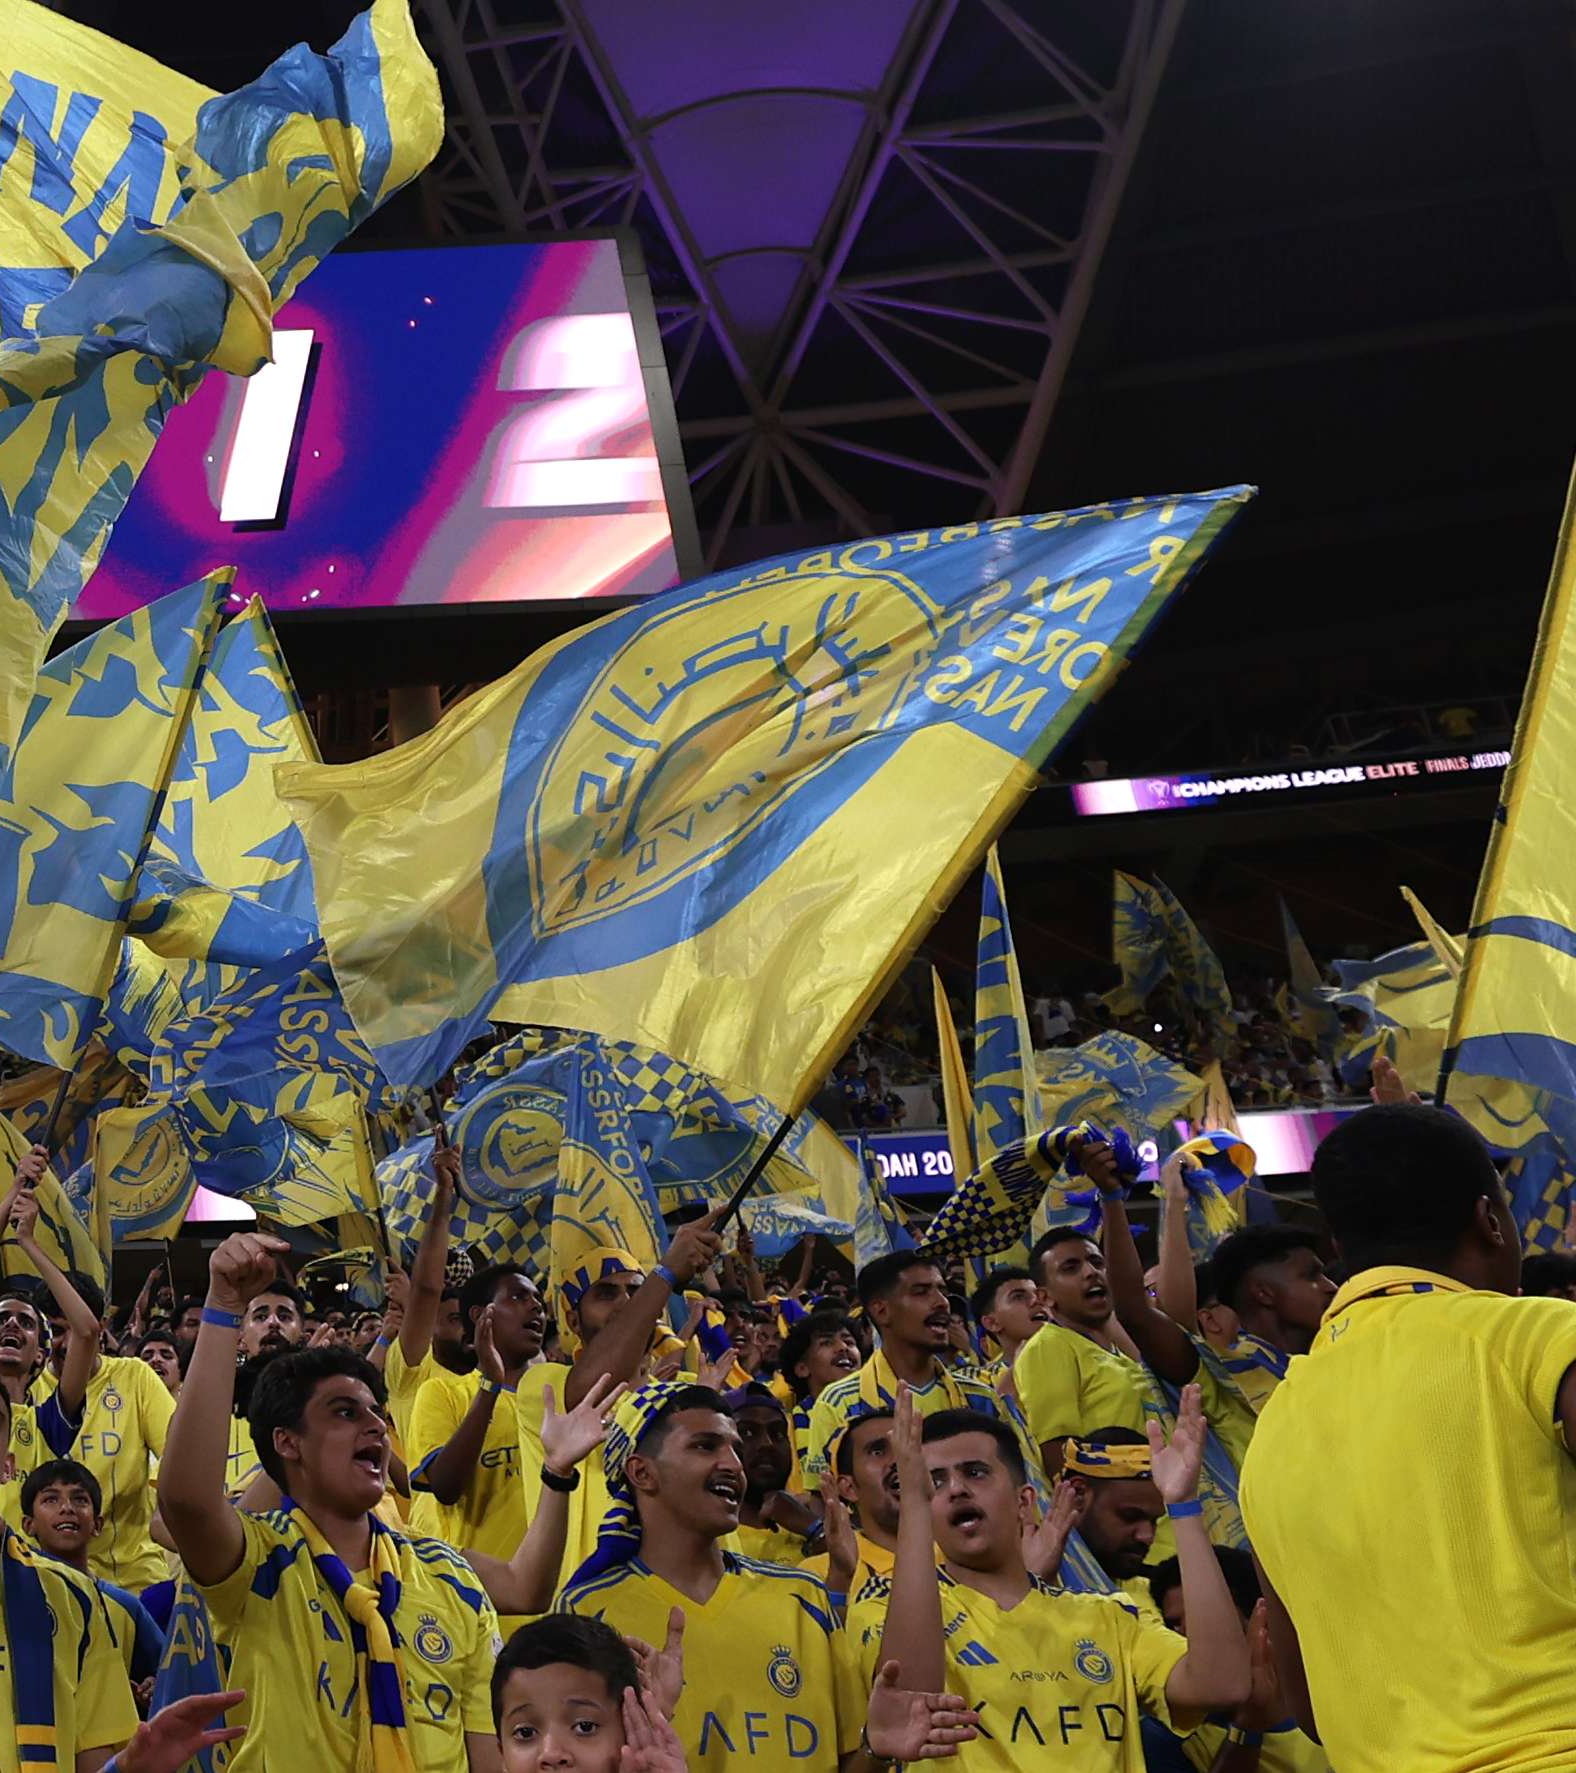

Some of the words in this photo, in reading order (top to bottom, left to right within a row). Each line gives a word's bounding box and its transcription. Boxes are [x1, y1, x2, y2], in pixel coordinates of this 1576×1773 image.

[1180, 773, 1292, 798] CHAMPIONS
[1292, 765, 1367, 788] LEAGUE
[1367, 761, 1420, 780] ELITE
[1425, 757, 1469, 774] FINALS
